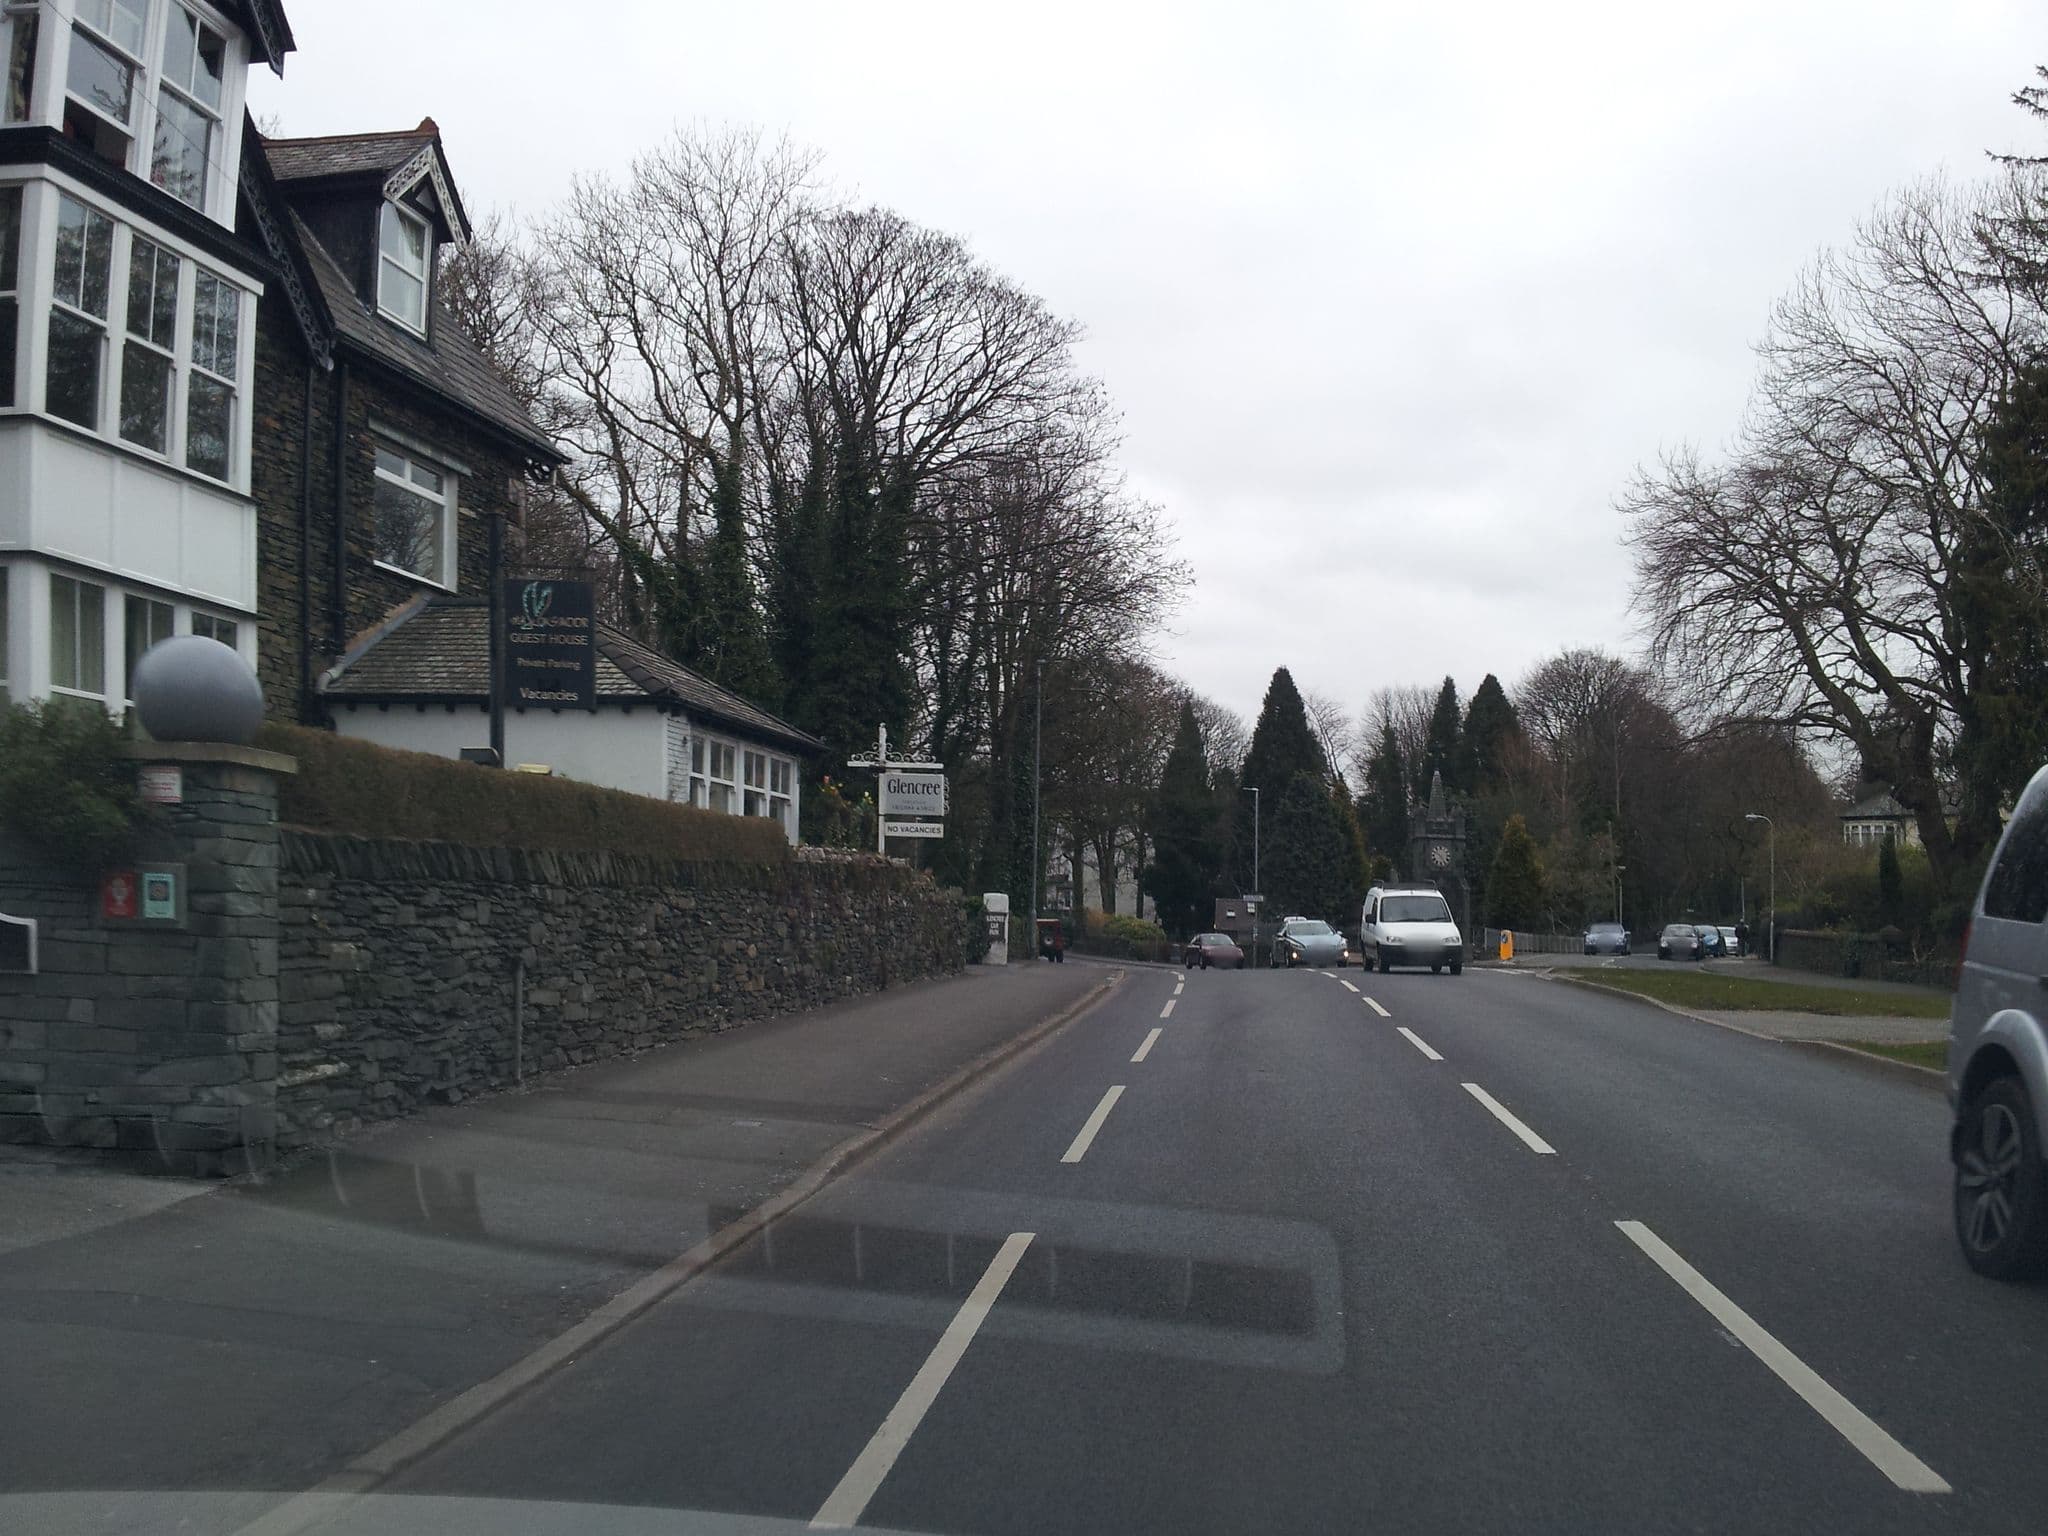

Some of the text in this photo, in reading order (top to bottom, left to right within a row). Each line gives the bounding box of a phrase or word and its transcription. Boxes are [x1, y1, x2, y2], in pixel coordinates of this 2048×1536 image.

[511, 632, 589, 646] GUEST HOUSE
[520, 687, 579, 701] Vacancies
[888, 778, 941, 796] Glencree
[888, 825, 941, 834] NO VACANCIES
